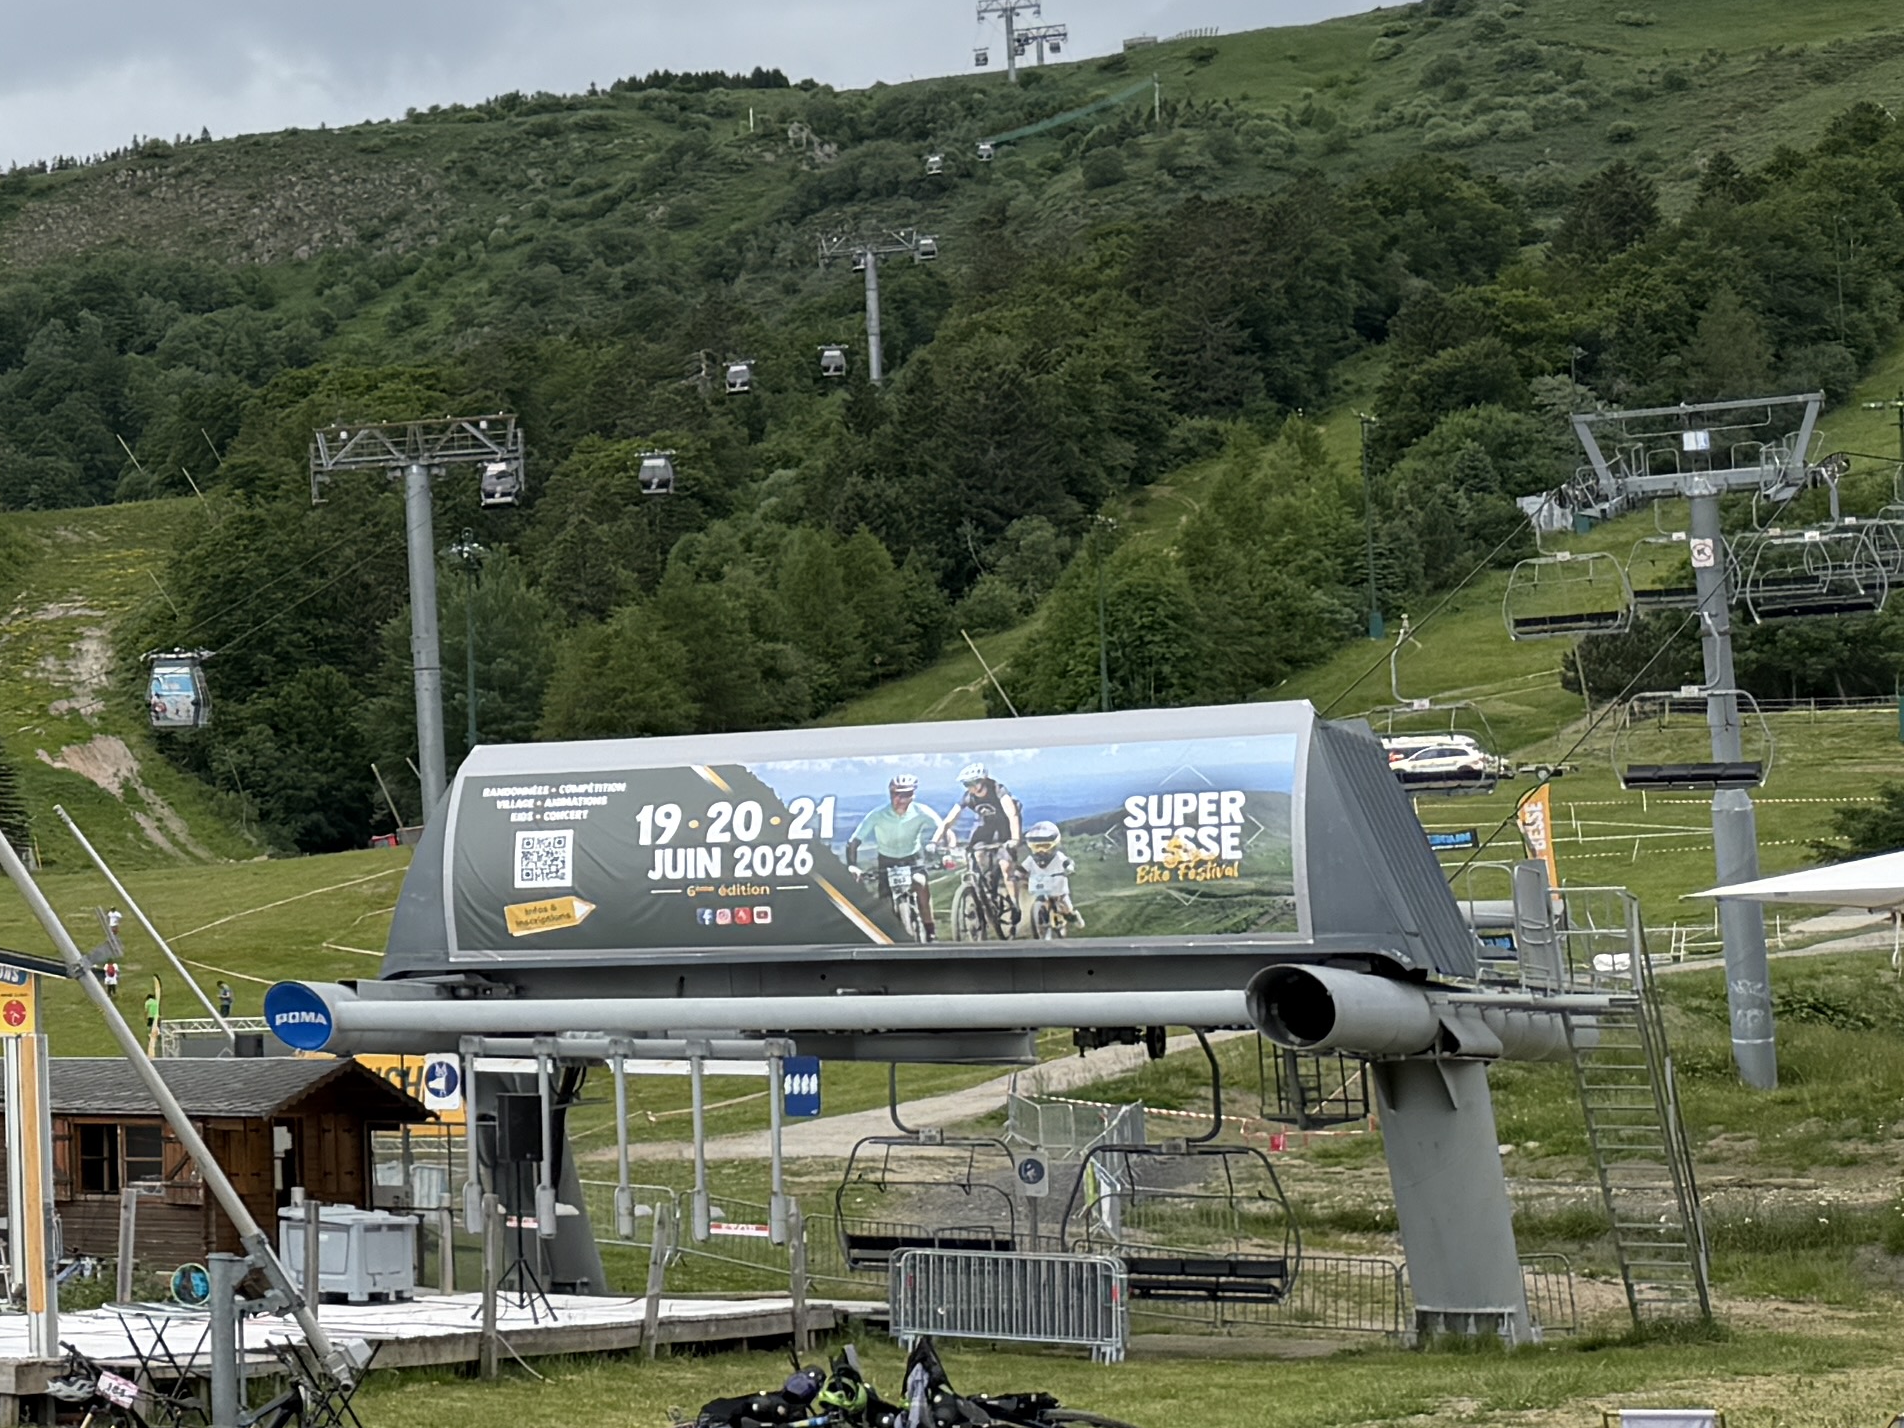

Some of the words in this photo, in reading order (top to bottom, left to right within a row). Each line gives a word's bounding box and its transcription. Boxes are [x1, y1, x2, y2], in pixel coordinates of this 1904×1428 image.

[483, 785, 549, 797] RANDONNÉES
[559, 782, 627, 794] COMPÉTITION
[496, 799, 534, 809] VILLAGE
[544, 796, 608, 808] ANIMATIONS
[1123, 790, 1246, 828] SUPER
[544, 810, 589, 821] CONCERT
[635, 803, 682, 845] 19
[705, 800, 763, 843] 20
[788, 796, 836, 840] 21
[1126, 825, 1243, 864] BESSE
[647, 846, 721, 880] JUIN
[733, 844, 814, 878] 2026
[1135, 864, 1172, 885] Bike
[1177, 861, 1239, 882] Festival
[718, 883, 771, 896] édition
[275, 1011, 328, 1026] POMA
